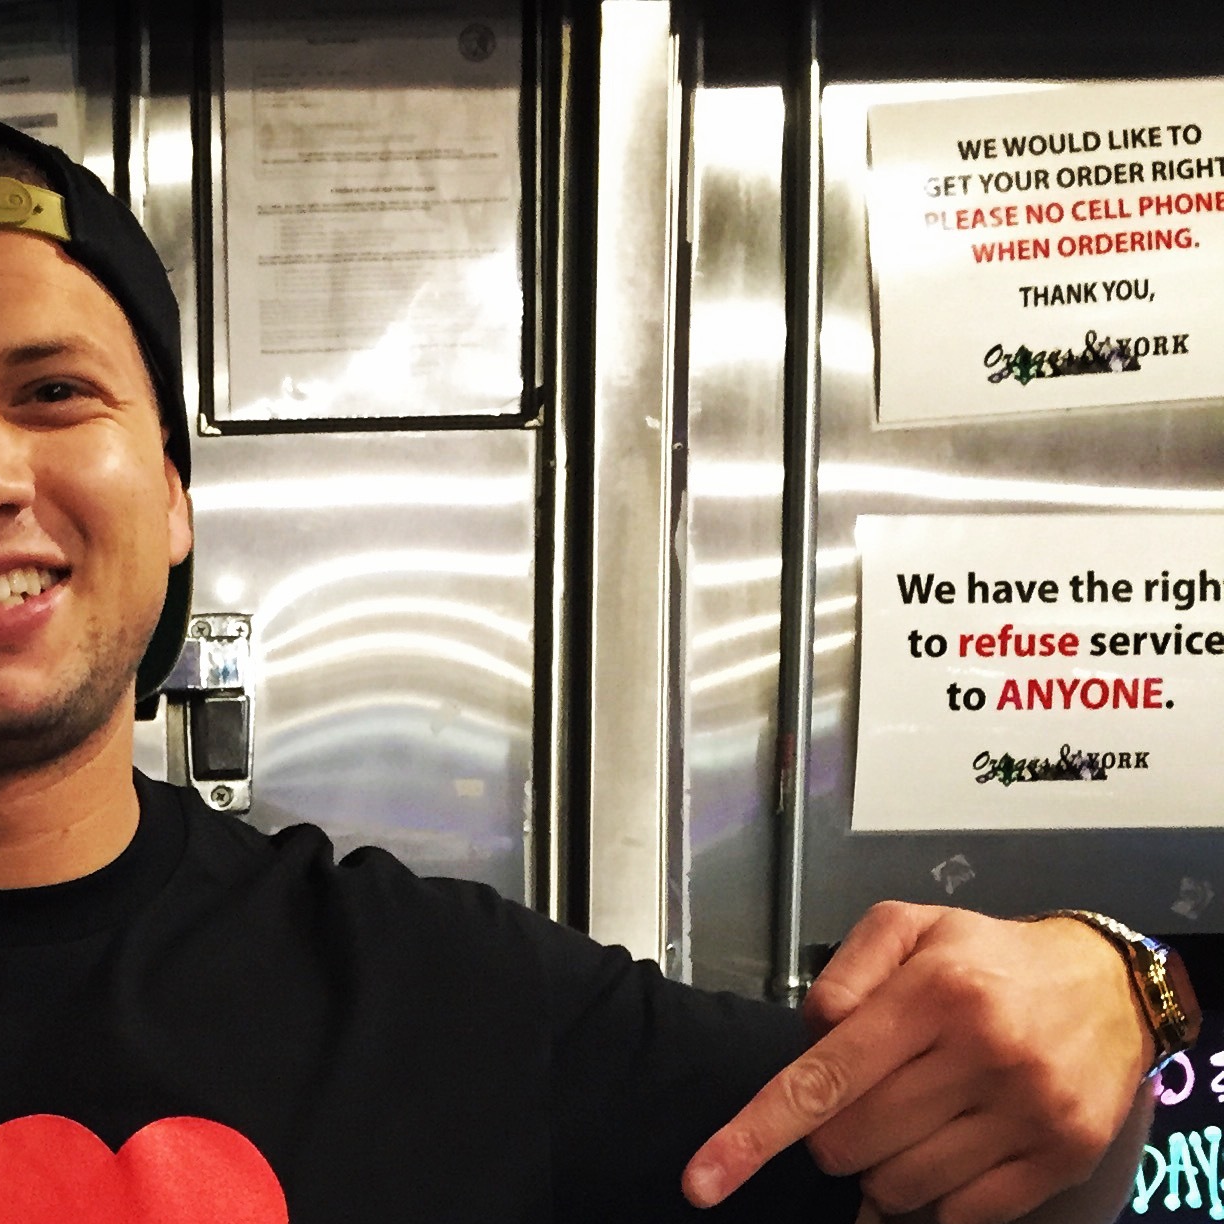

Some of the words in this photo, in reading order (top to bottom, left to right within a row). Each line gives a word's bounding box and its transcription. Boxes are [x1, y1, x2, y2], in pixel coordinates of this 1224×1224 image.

[958, 139, 997, 161] WE
[1003, 131, 1101, 158] WOULD
[1108, 127, 1162, 150] LIKE
[1167, 124, 1202, 145] TO
[924, 175, 972, 198] GET
[979, 169, 1050, 193] YOUR
[1057, 162, 1144, 188] ORDER
[1152, 157, 1224, 181] RIGHT
[925, 203, 1019, 231] PLEASE
[1026, 202, 1064, 225] NO
[1072, 199, 1131, 221] CELL
[1139, 191, 1224, 216] PHONE
[971, 239, 1049, 263] WHEN
[1058, 228, 1200, 257] ORDERING.
[1019, 282, 1097, 307] THANK
[1103, 279, 1155, 302] YOU,
[897, 573, 955, 604] We
[968, 572, 1059, 604] have
[1070, 571, 1132, 603] the
[1145, 569, 1224, 610] righ
[908, 630, 947, 658] to
[959, 624, 1079, 657] refuse
[1090, 623, 1224, 656] service
[947, 683, 986, 711] to
[996, 678, 1174, 711] ANYONE.
